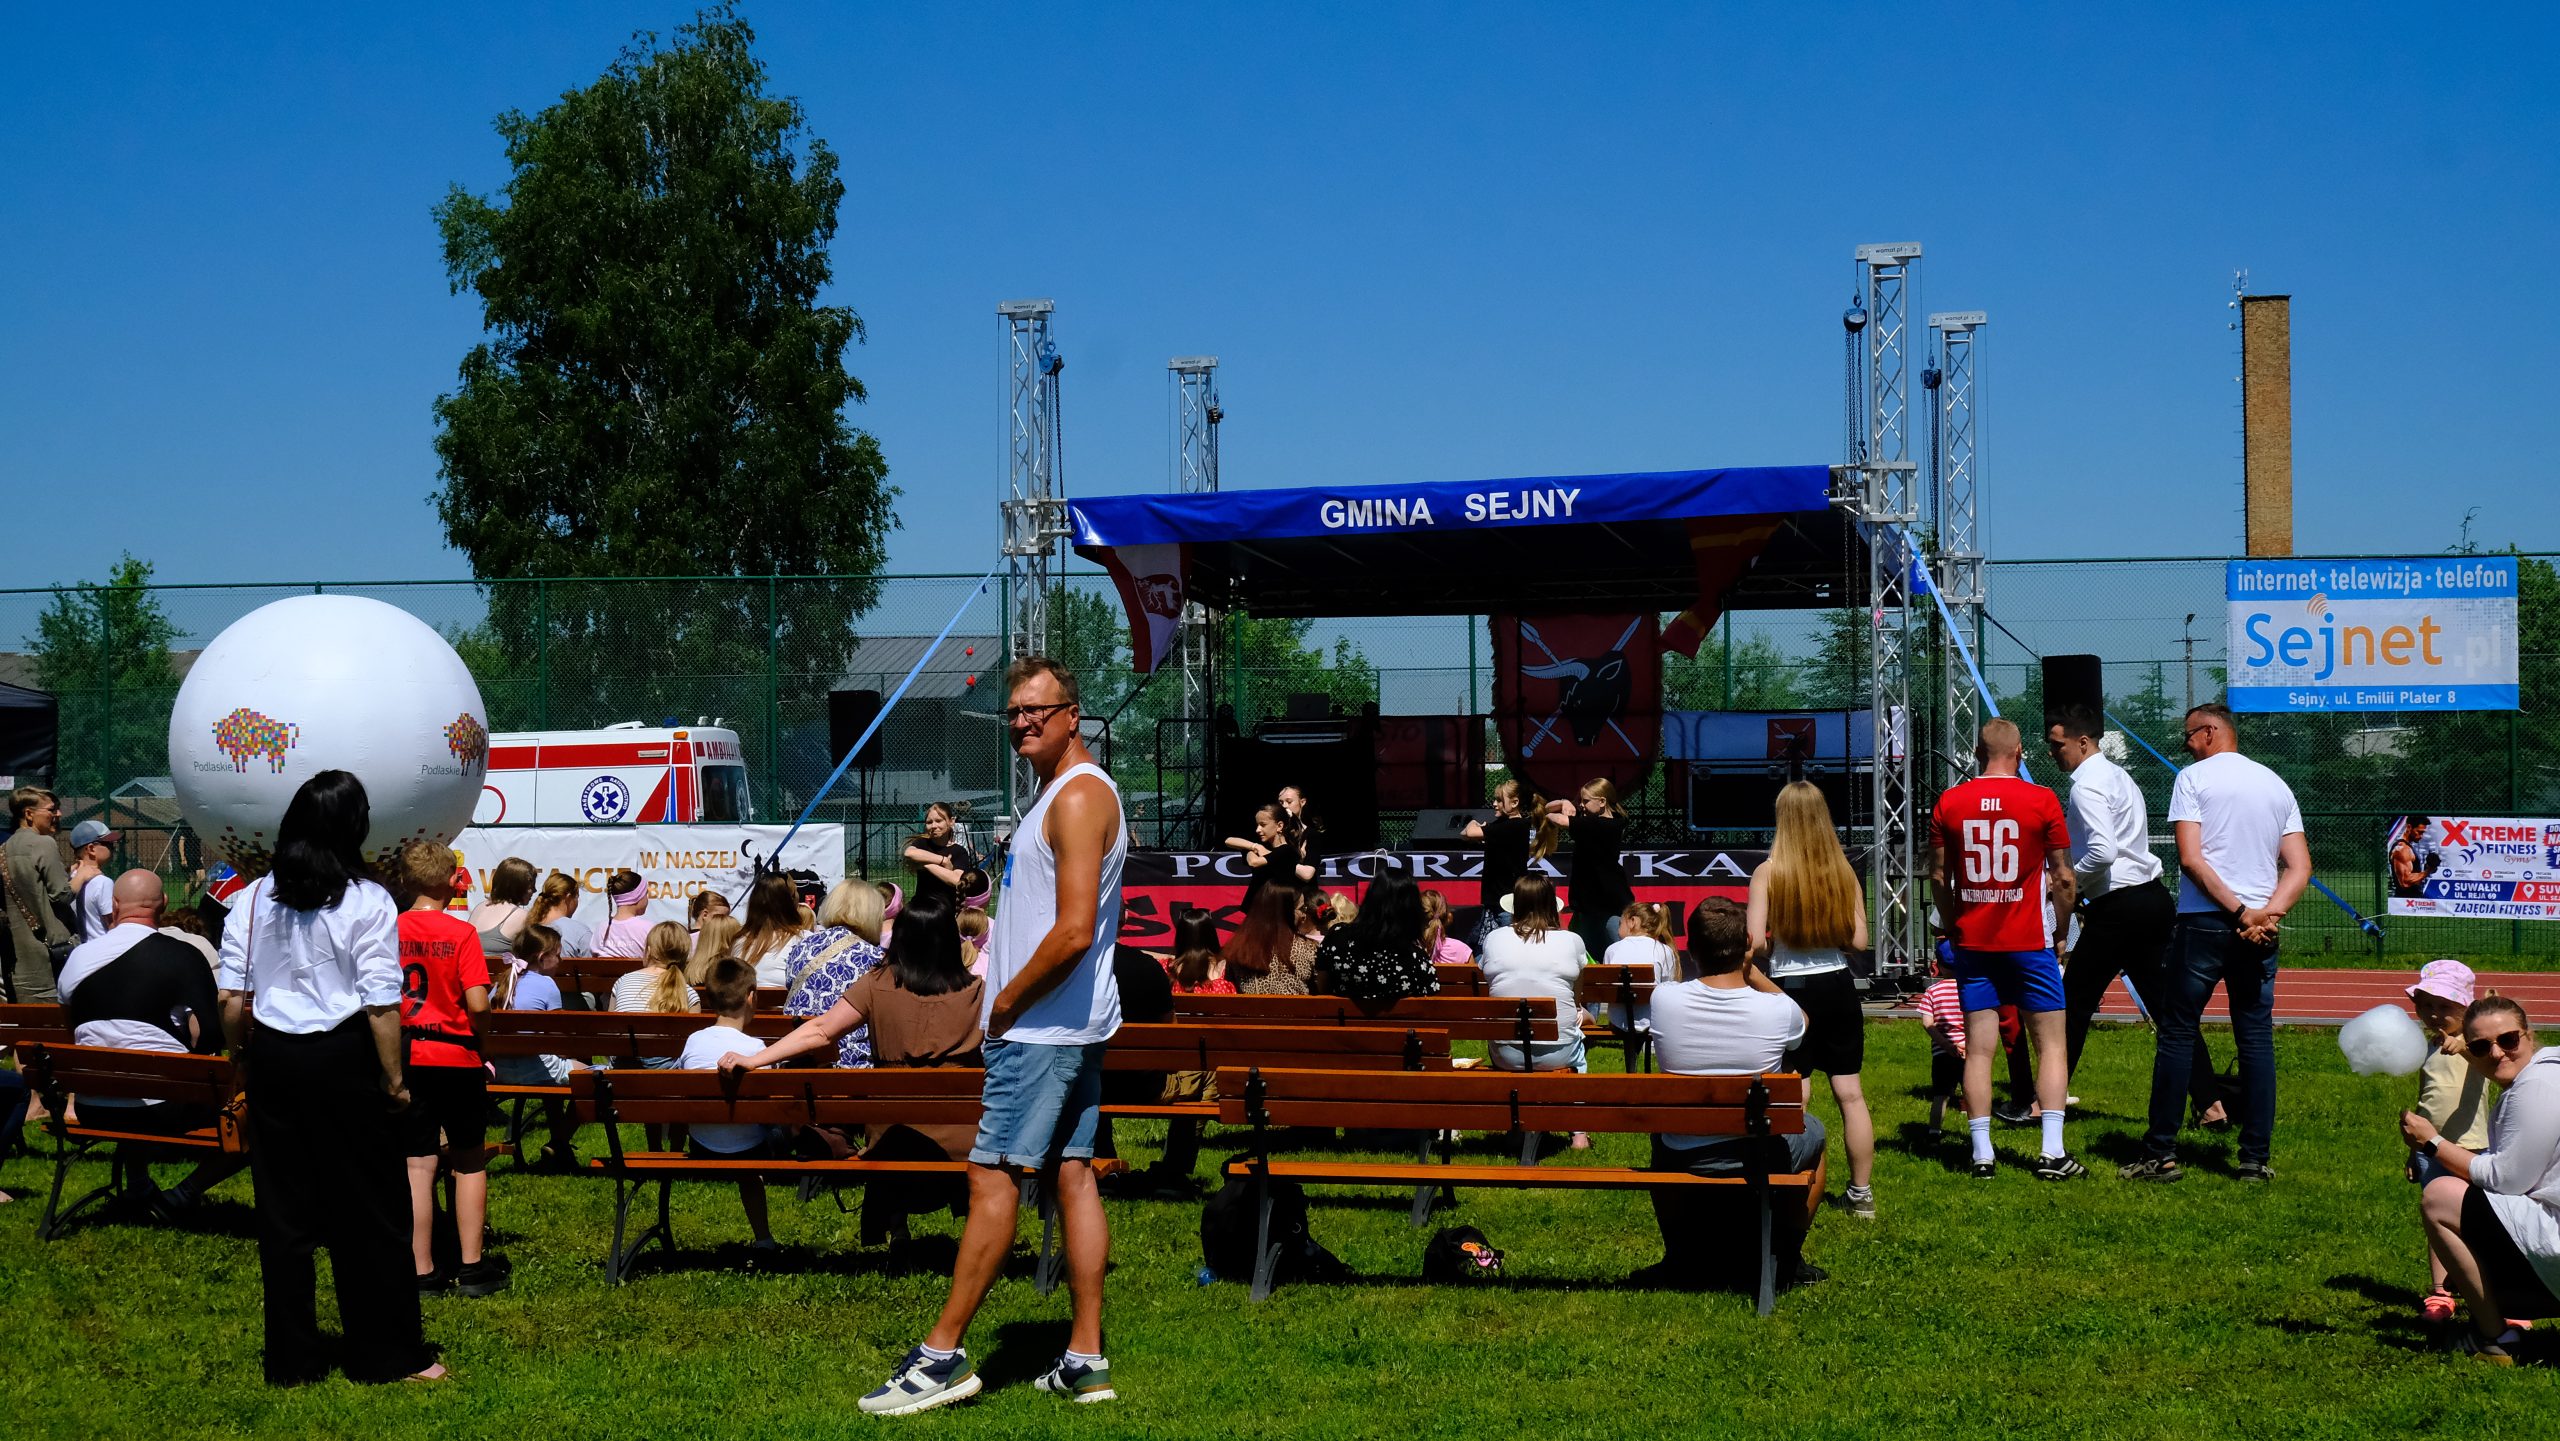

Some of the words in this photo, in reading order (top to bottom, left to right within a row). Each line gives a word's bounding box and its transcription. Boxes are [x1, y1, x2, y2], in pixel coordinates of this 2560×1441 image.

[1320, 497, 1435, 529] GMINA
[1463, 488, 1581, 522] SEJNY
[2238, 567, 2318, 591] internet
[2330, 566, 2423, 596] telewizja
[2436, 564, 2508, 588] telefon
[2335, 692, 2351, 705] ul.
[2357, 691, 2395, 705] Emilii
[2400, 691, 2442, 704] Plater
[2447, 691, 2457, 704] 8
[193, 761, 233, 773] Podlaskie
[421, 764, 461, 776] Podlaskie
[1980, 798, 2003, 811] BIL
[2440, 820, 2537, 847] XTREME
[1962, 818, 2020, 883] 56
[2486, 843, 2537, 855] FITNESS
[639, 851, 660, 869] W
[665, 850, 738, 869] NASZEJ
[2454, 882, 2501, 893] SUWAŁKI
[2454, 902, 2496, 916] ZAJĘCIA
[2499, 904, 2541, 916] FITNESS
